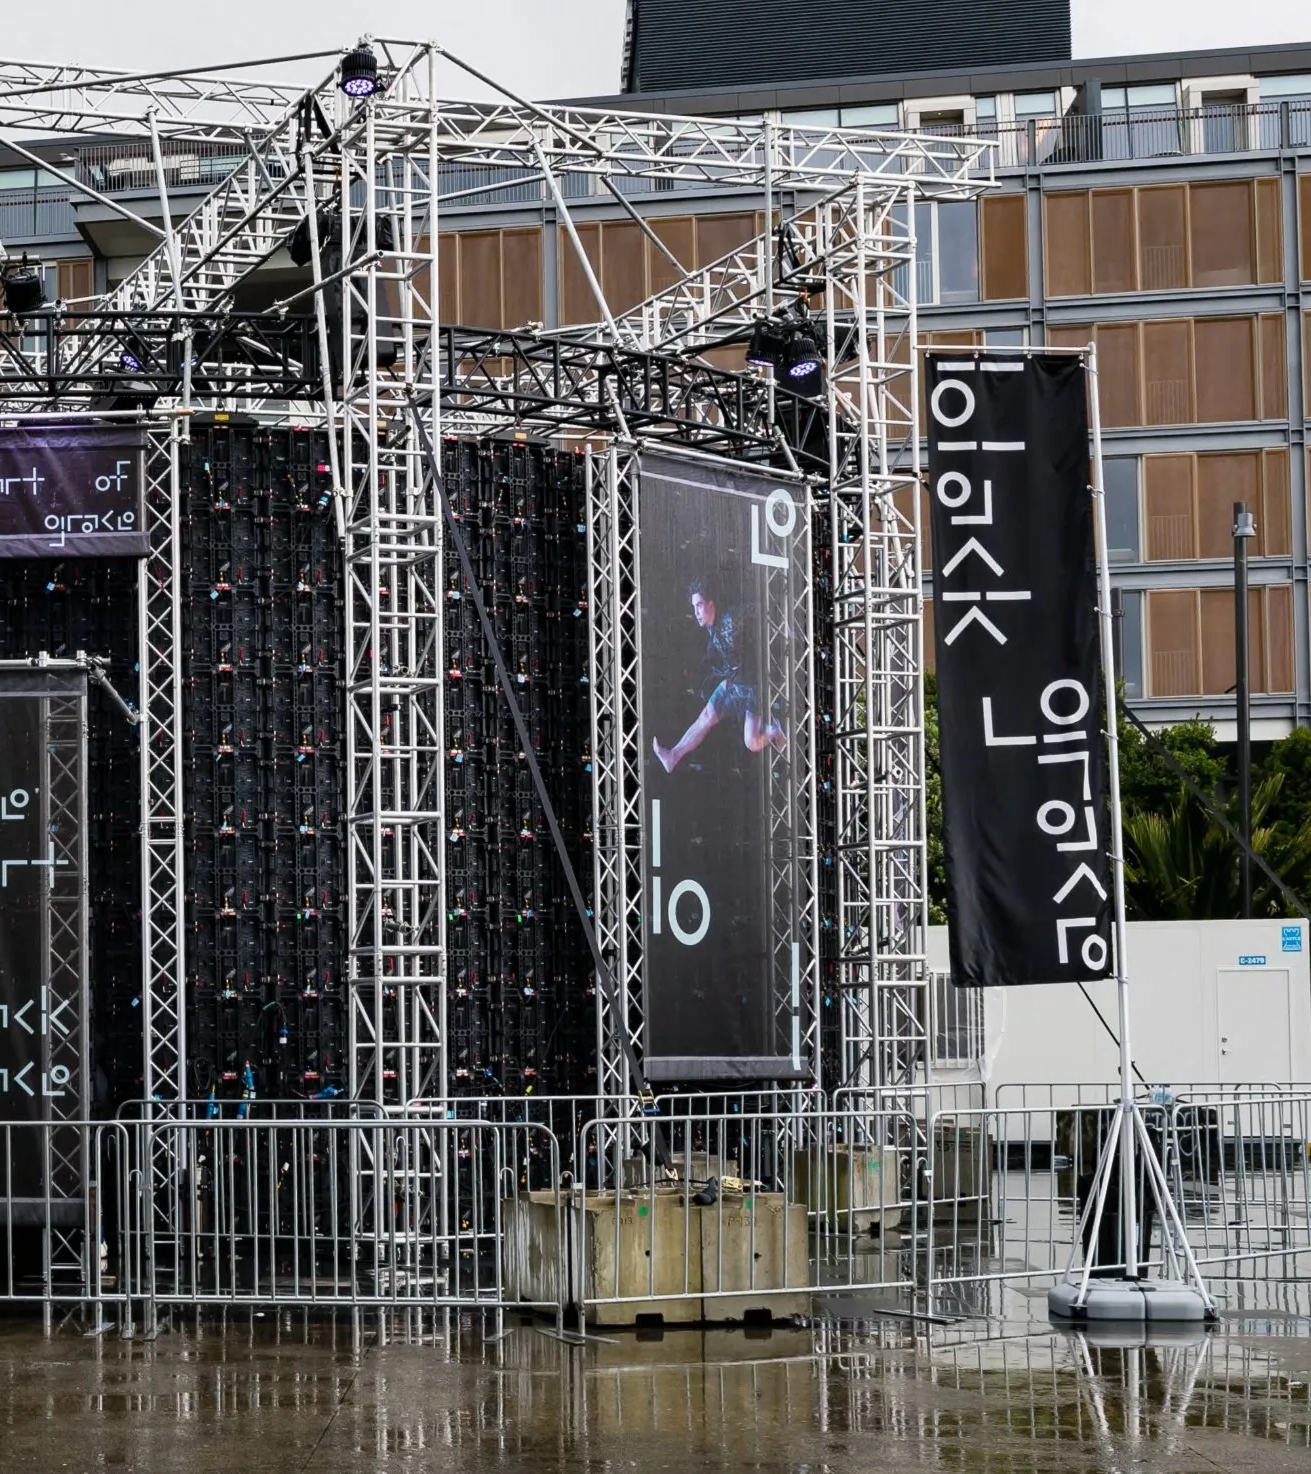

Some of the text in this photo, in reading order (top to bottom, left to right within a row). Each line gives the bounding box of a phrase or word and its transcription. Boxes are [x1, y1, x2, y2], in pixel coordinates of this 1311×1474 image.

[95, 460, 131, 491] of
[44, 510, 135, 546] grace
[931, 361, 1108, 970] black grace
